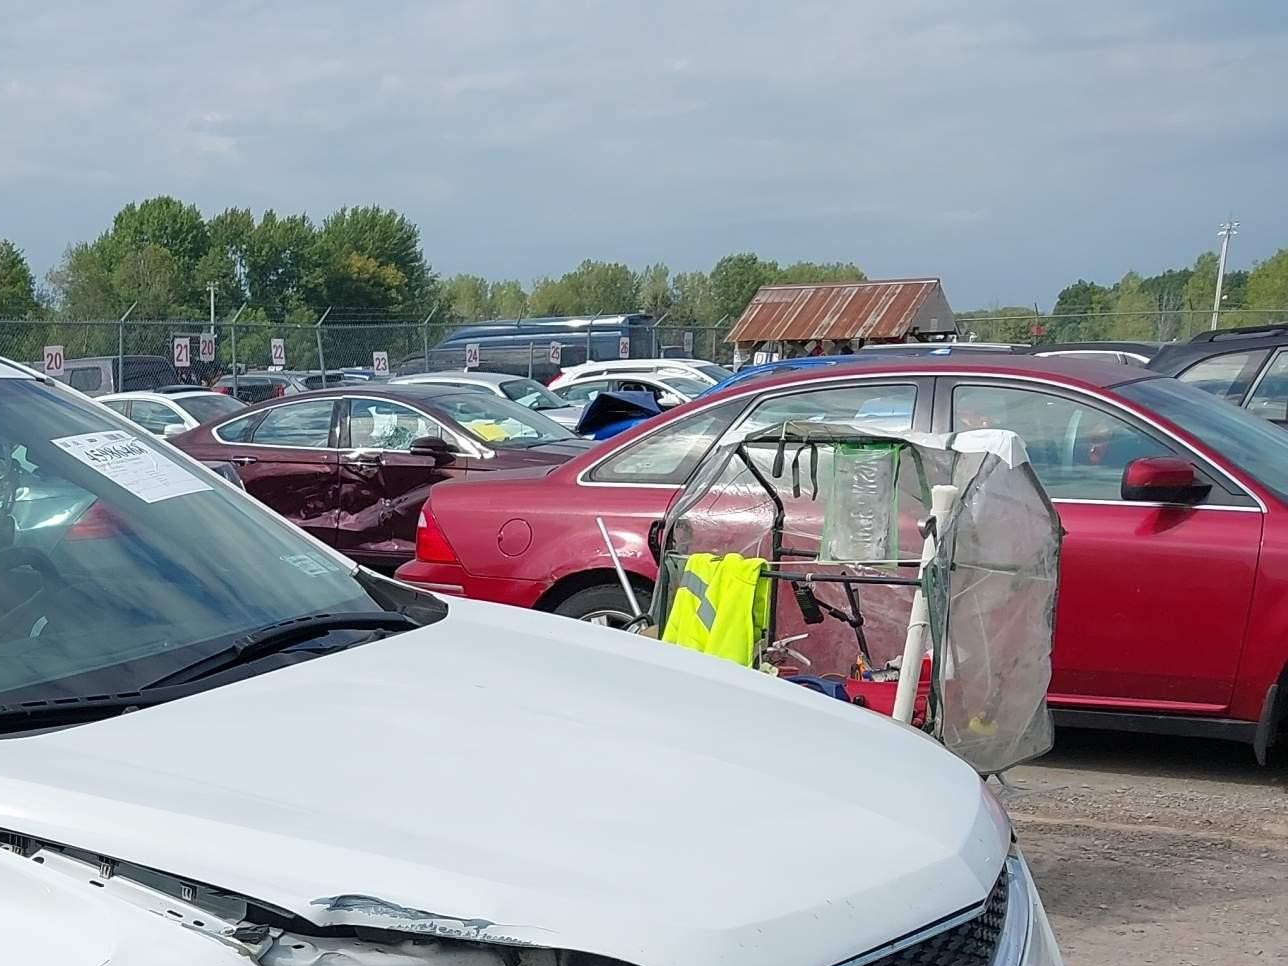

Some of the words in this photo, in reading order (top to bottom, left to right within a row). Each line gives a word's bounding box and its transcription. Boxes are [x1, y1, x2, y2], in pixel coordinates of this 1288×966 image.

[175, 342, 190, 363] 21
[200, 339, 214, 356] 20
[272, 348, 285, 361] 22
[467, 348, 479, 363] 24
[46, 352, 63, 371] 20
[375, 357, 388, 372] 23
